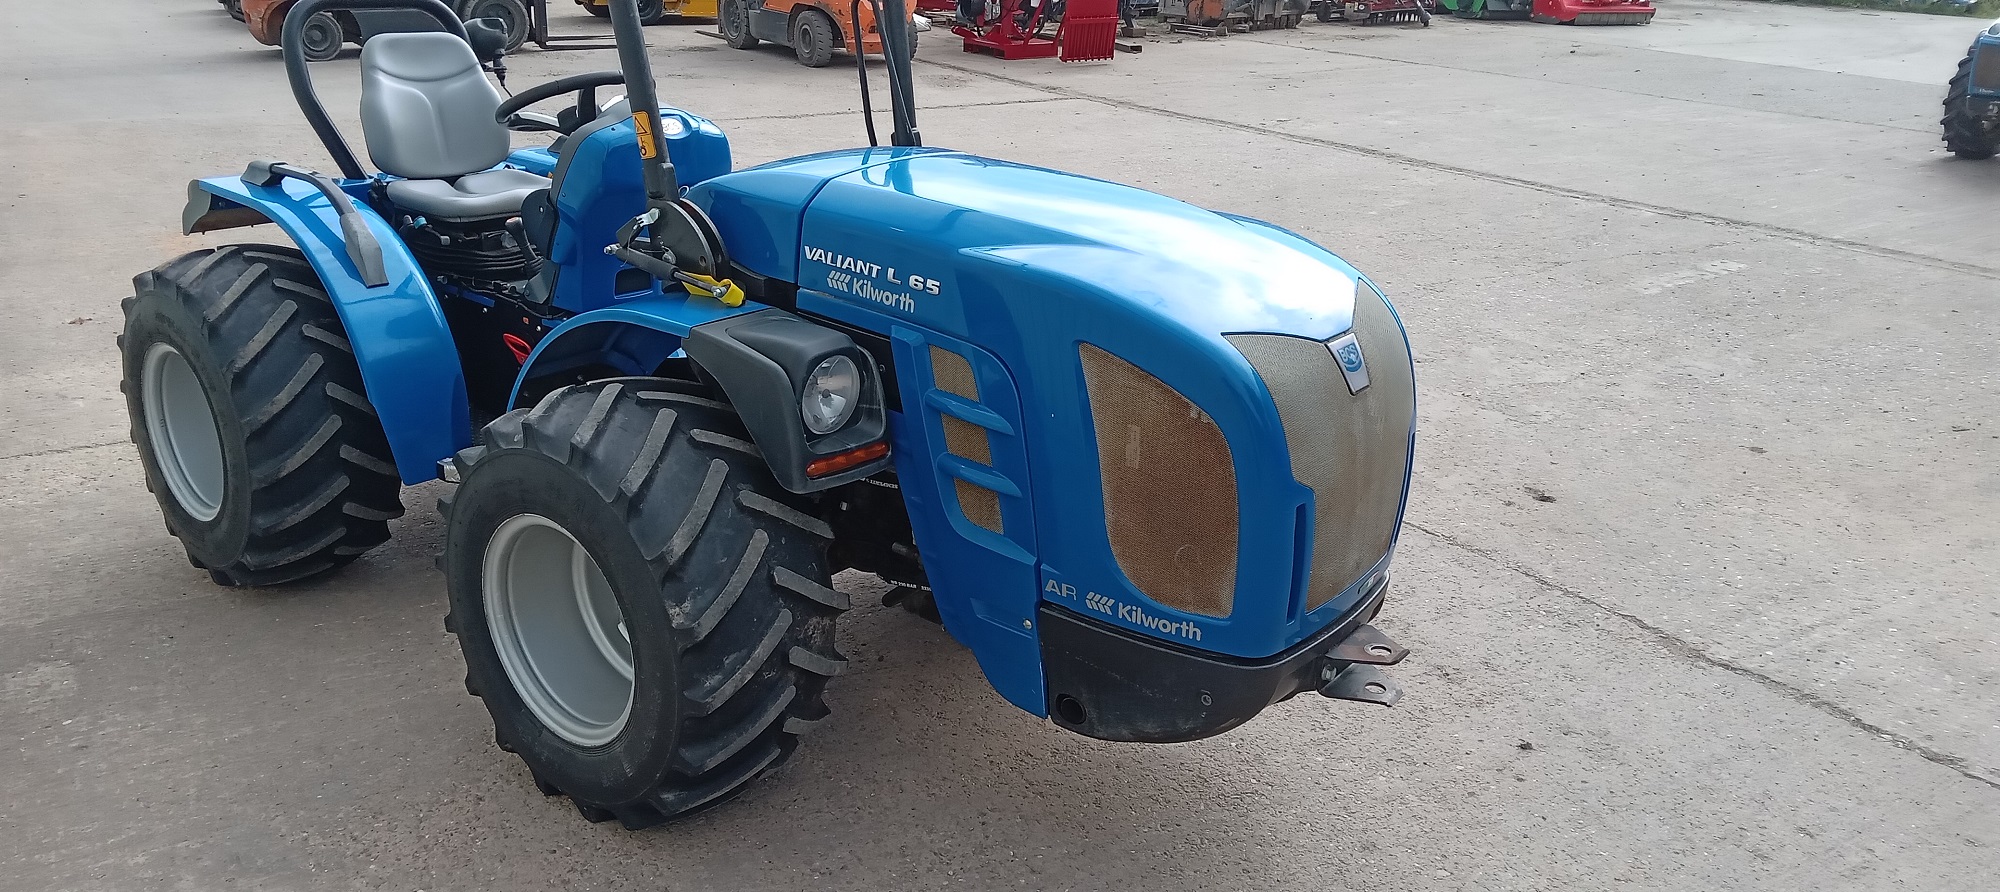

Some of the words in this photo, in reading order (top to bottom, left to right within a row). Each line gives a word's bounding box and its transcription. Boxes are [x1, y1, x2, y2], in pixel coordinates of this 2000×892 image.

[804, 245, 881, 278] VALIANT
[887, 267, 902, 285] L
[909, 274, 941, 295] 65
[852, 277, 915, 313] Kilworth
[1045, 579, 1077, 600] AR
[1117, 602, 1202, 641] Kilworth
